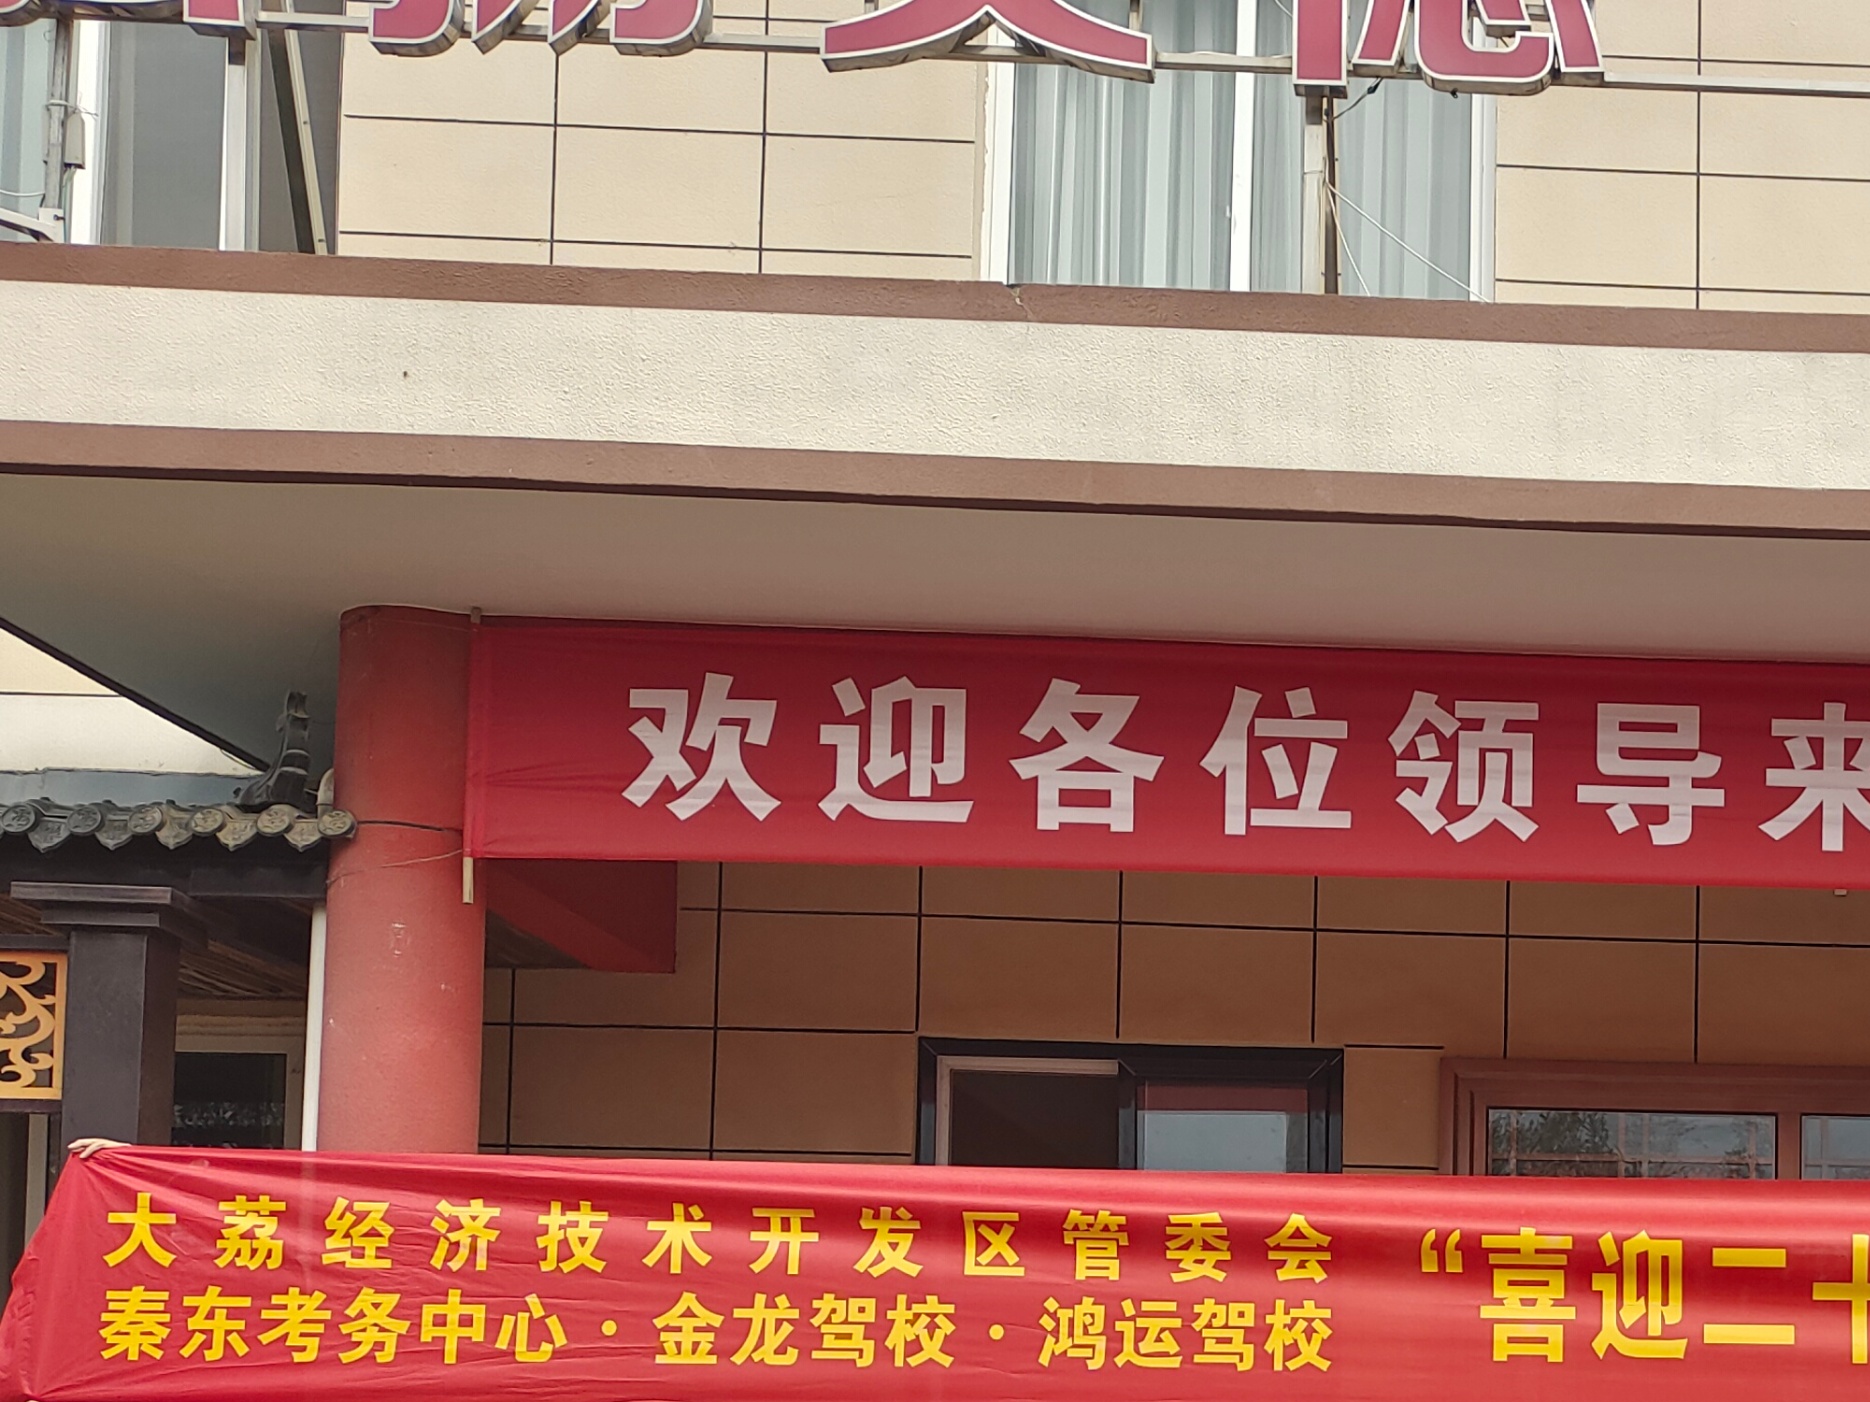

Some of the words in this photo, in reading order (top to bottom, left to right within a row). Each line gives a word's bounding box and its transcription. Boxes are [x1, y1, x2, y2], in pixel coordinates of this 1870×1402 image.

[104, 1191, 1333, 1283] 大荔经济技术开发区管委会
